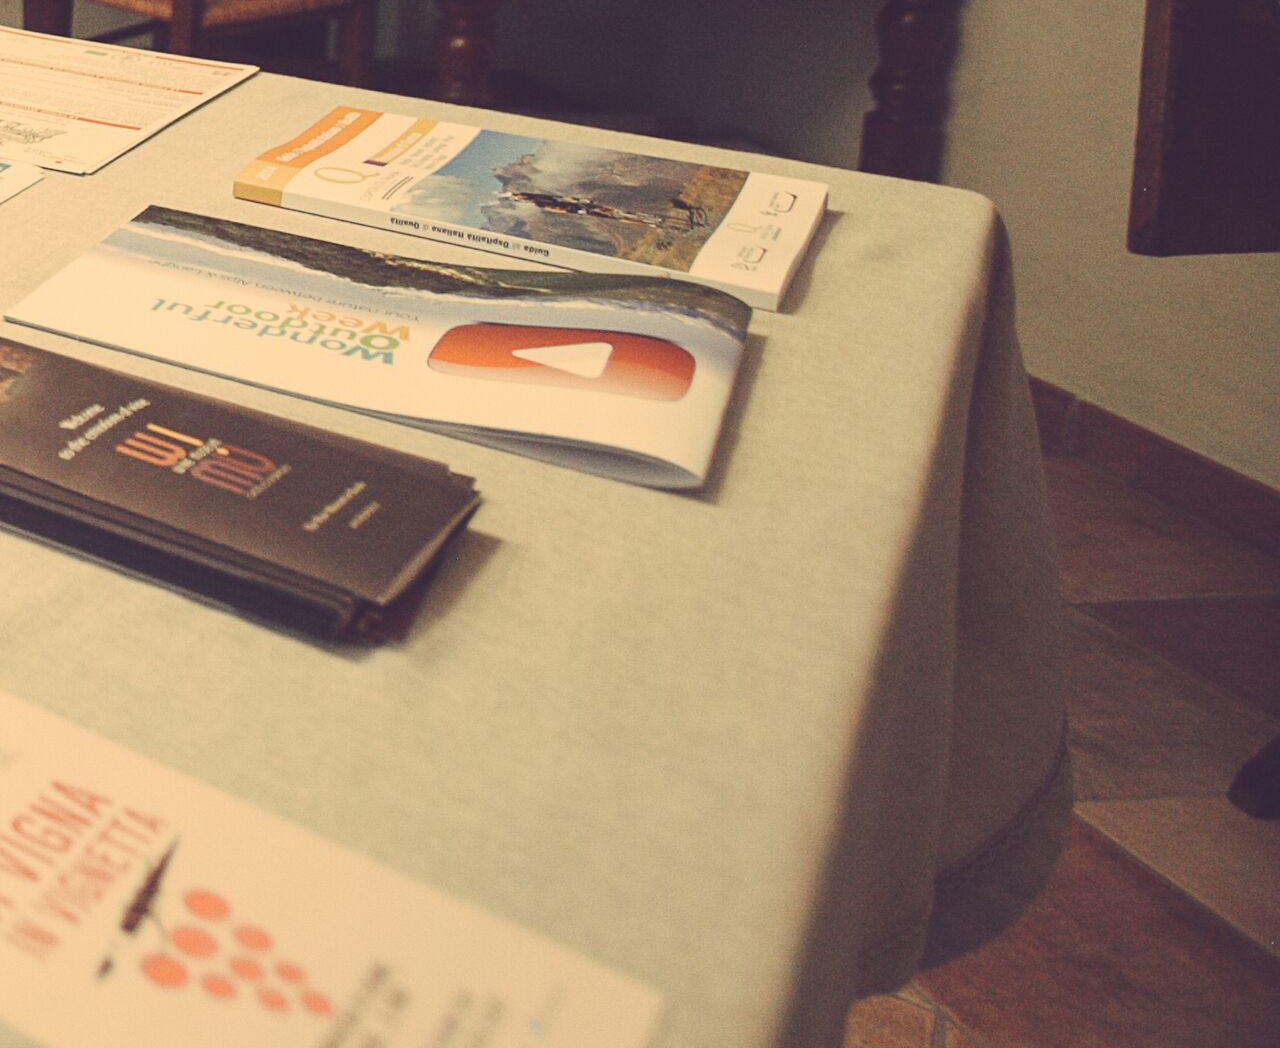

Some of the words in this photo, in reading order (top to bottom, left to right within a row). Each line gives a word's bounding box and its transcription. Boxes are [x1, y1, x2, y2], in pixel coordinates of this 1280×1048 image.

[389, 217, 420, 231] Qualità
[431, 225, 465, 239] Italiana
[466, 233, 510, 249] Ospitalità
[523, 245, 550, 257] Guida
[256, 281, 323, 302] between
[150, 297, 394, 365] Wonderful
[204, 300, 401, 351] Outdoor
[288, 303, 411, 341] Week
[32, 807, 167, 926] VIGNETTA
